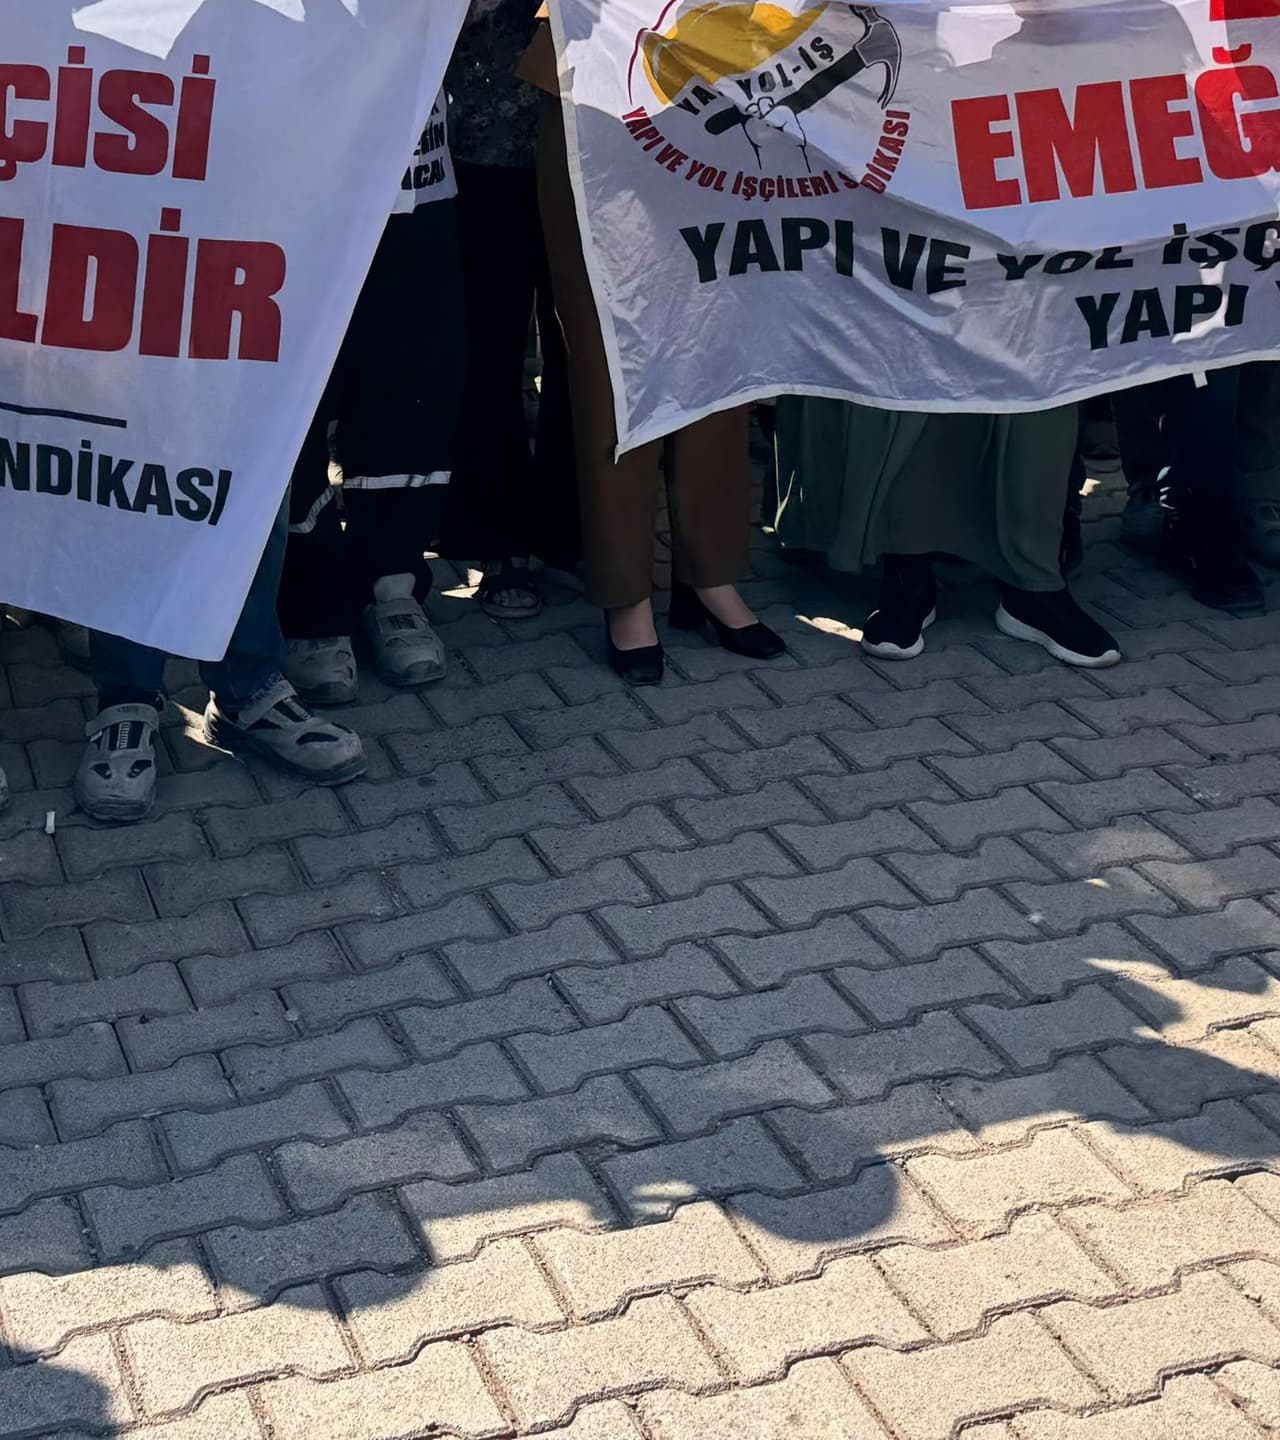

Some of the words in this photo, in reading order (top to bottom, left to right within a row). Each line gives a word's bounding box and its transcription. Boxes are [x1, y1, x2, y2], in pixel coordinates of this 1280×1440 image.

[676, 85, 725, 116] YA
[735, 35, 835, 101] YOL-İŞ
[621, 105, 666, 153] YAPI
[654, 143, 689, 174] VE
[684, 159, 727, 193] YOL
[731, 170, 840, 203] İŞÇİLERİ
[837, 109, 911, 195] DİKASI
[679, 217, 855, 284] YAPI
[880, 226, 972, 296] VE
[1075, 282, 1250, 351] YAPI
